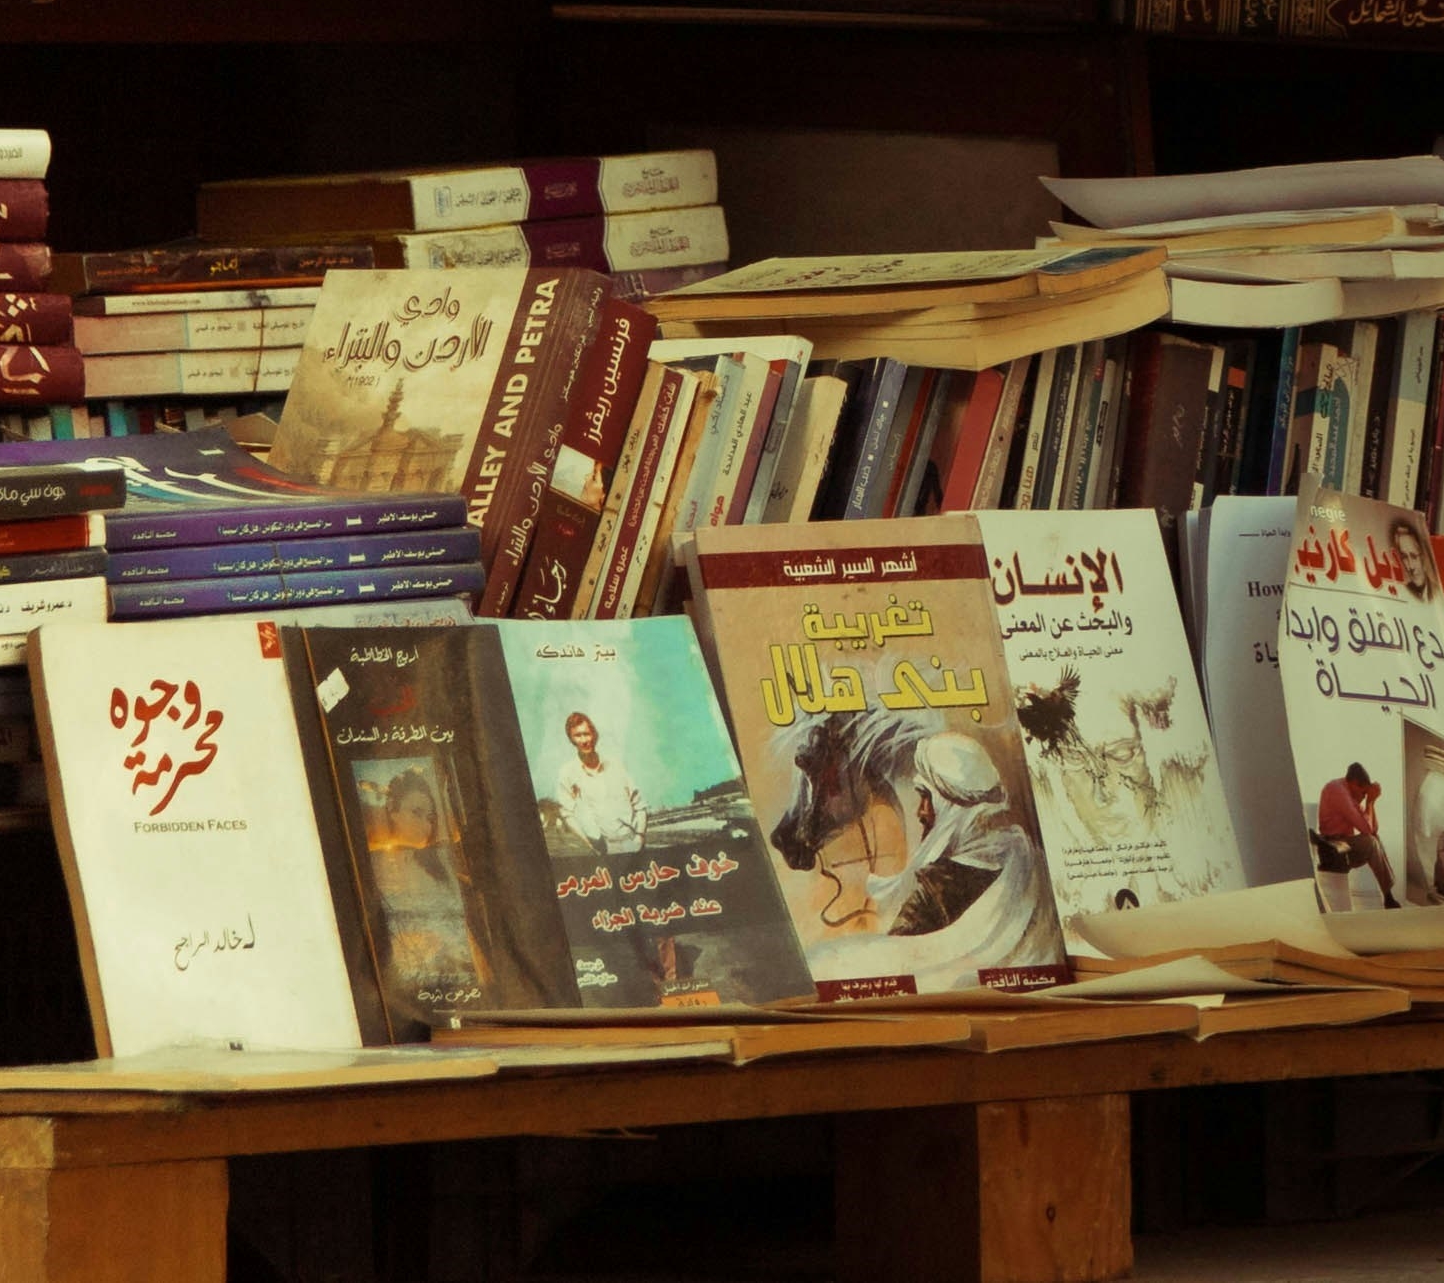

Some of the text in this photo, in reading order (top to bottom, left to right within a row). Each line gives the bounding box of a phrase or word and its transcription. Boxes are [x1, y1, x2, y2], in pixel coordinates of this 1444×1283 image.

[395, 285, 461, 322] وادي
[322, 313, 494, 372] الأردن والبتراء
[467, 279, 559, 527] ALLEY AND PETRA
[19, 488, 42, 505] سي
[42, 484, 67, 502] جون
[1309, 503, 1347, 523] negie
[782, 551, 918, 580] أشهر السير الشعبية
[993, 548, 1125, 614] الإنسان
[1363, 546, 1404, 596] ديل
[1247, 580, 1284, 599] How
[801, 593, 934, 649] تغريبة
[999, 609, 1134, 642] والبحث عن المعنى
[1348, 614, 1411, 656] القلق
[535, 644, 617, 662] بيتر هاندكه
[1076, 646, 1101, 661] الحياة
[1101, 646, 1125, 660] معنى
[759, 642, 868, 728] هلال
[1315, 671, 1437, 714] الحياة
[109, 678, 203, 749] وجوه
[429, 724, 455, 744] بين
[122, 709, 224, 817] محرمة
[133, 819, 248, 834] FORBIDDEN FACES
[556, 851, 739, 899] خوف حارس المرمى
[591, 898, 722, 933] عند ضربة الجزاء
[1022, 975, 1057, 989] مكتبة
